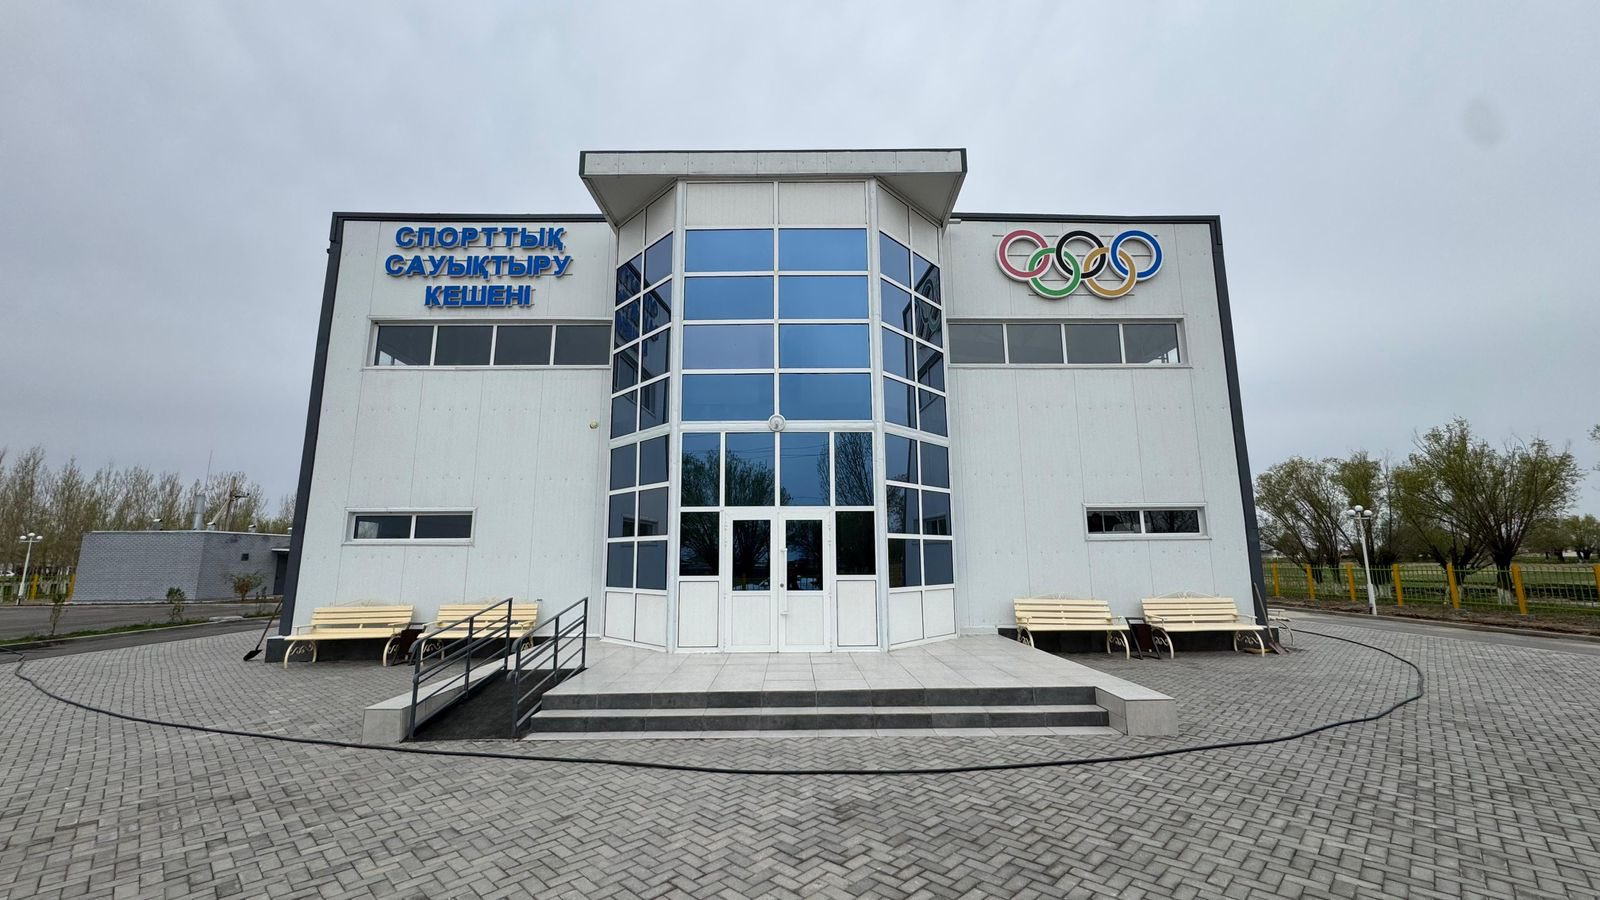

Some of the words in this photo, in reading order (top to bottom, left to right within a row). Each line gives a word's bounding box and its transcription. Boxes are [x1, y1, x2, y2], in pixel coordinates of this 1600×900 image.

[395, 227, 566, 252] СПОРТТЫҚ
[385, 254, 572, 280] САУЫҚТЫРУ
[424, 285, 533, 307] КЕШЕНІ
